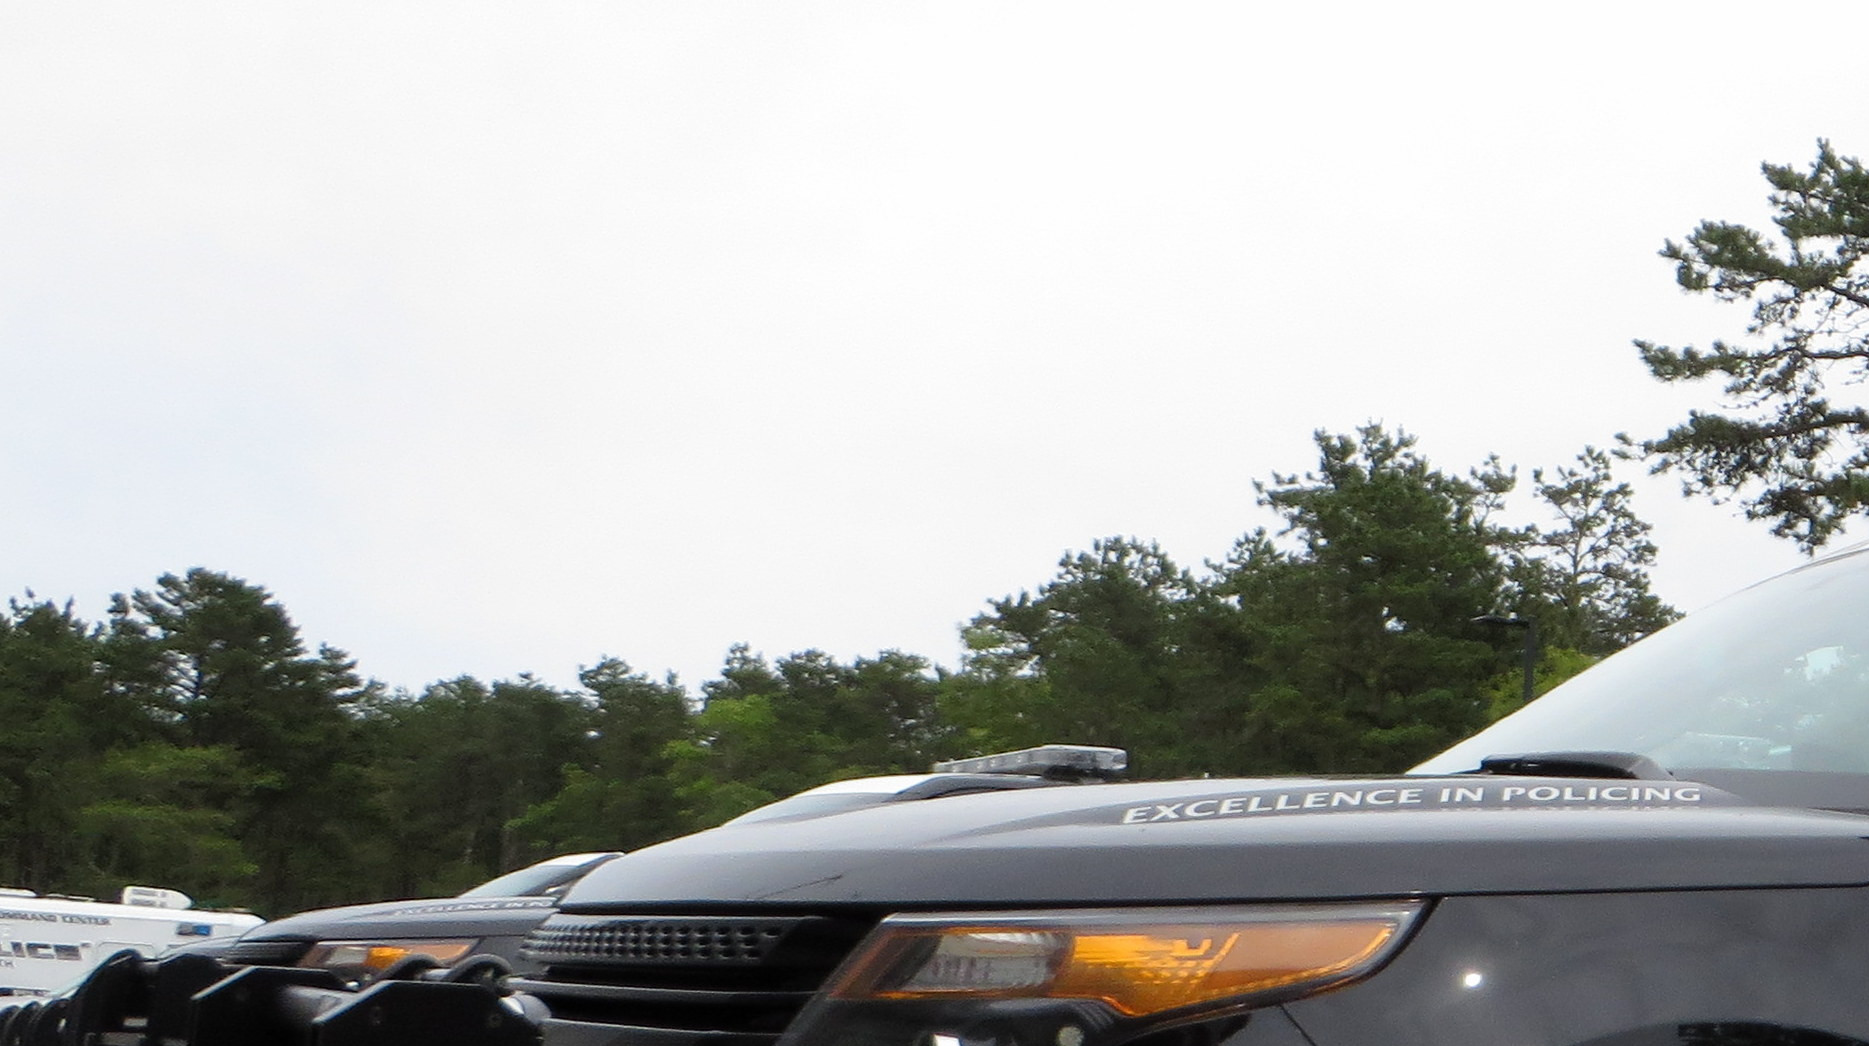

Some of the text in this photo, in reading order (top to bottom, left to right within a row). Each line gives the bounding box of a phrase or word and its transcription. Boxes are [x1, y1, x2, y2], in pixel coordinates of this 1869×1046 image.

[1122, 786, 1702, 825] EXCELLENCE IN POLICING
